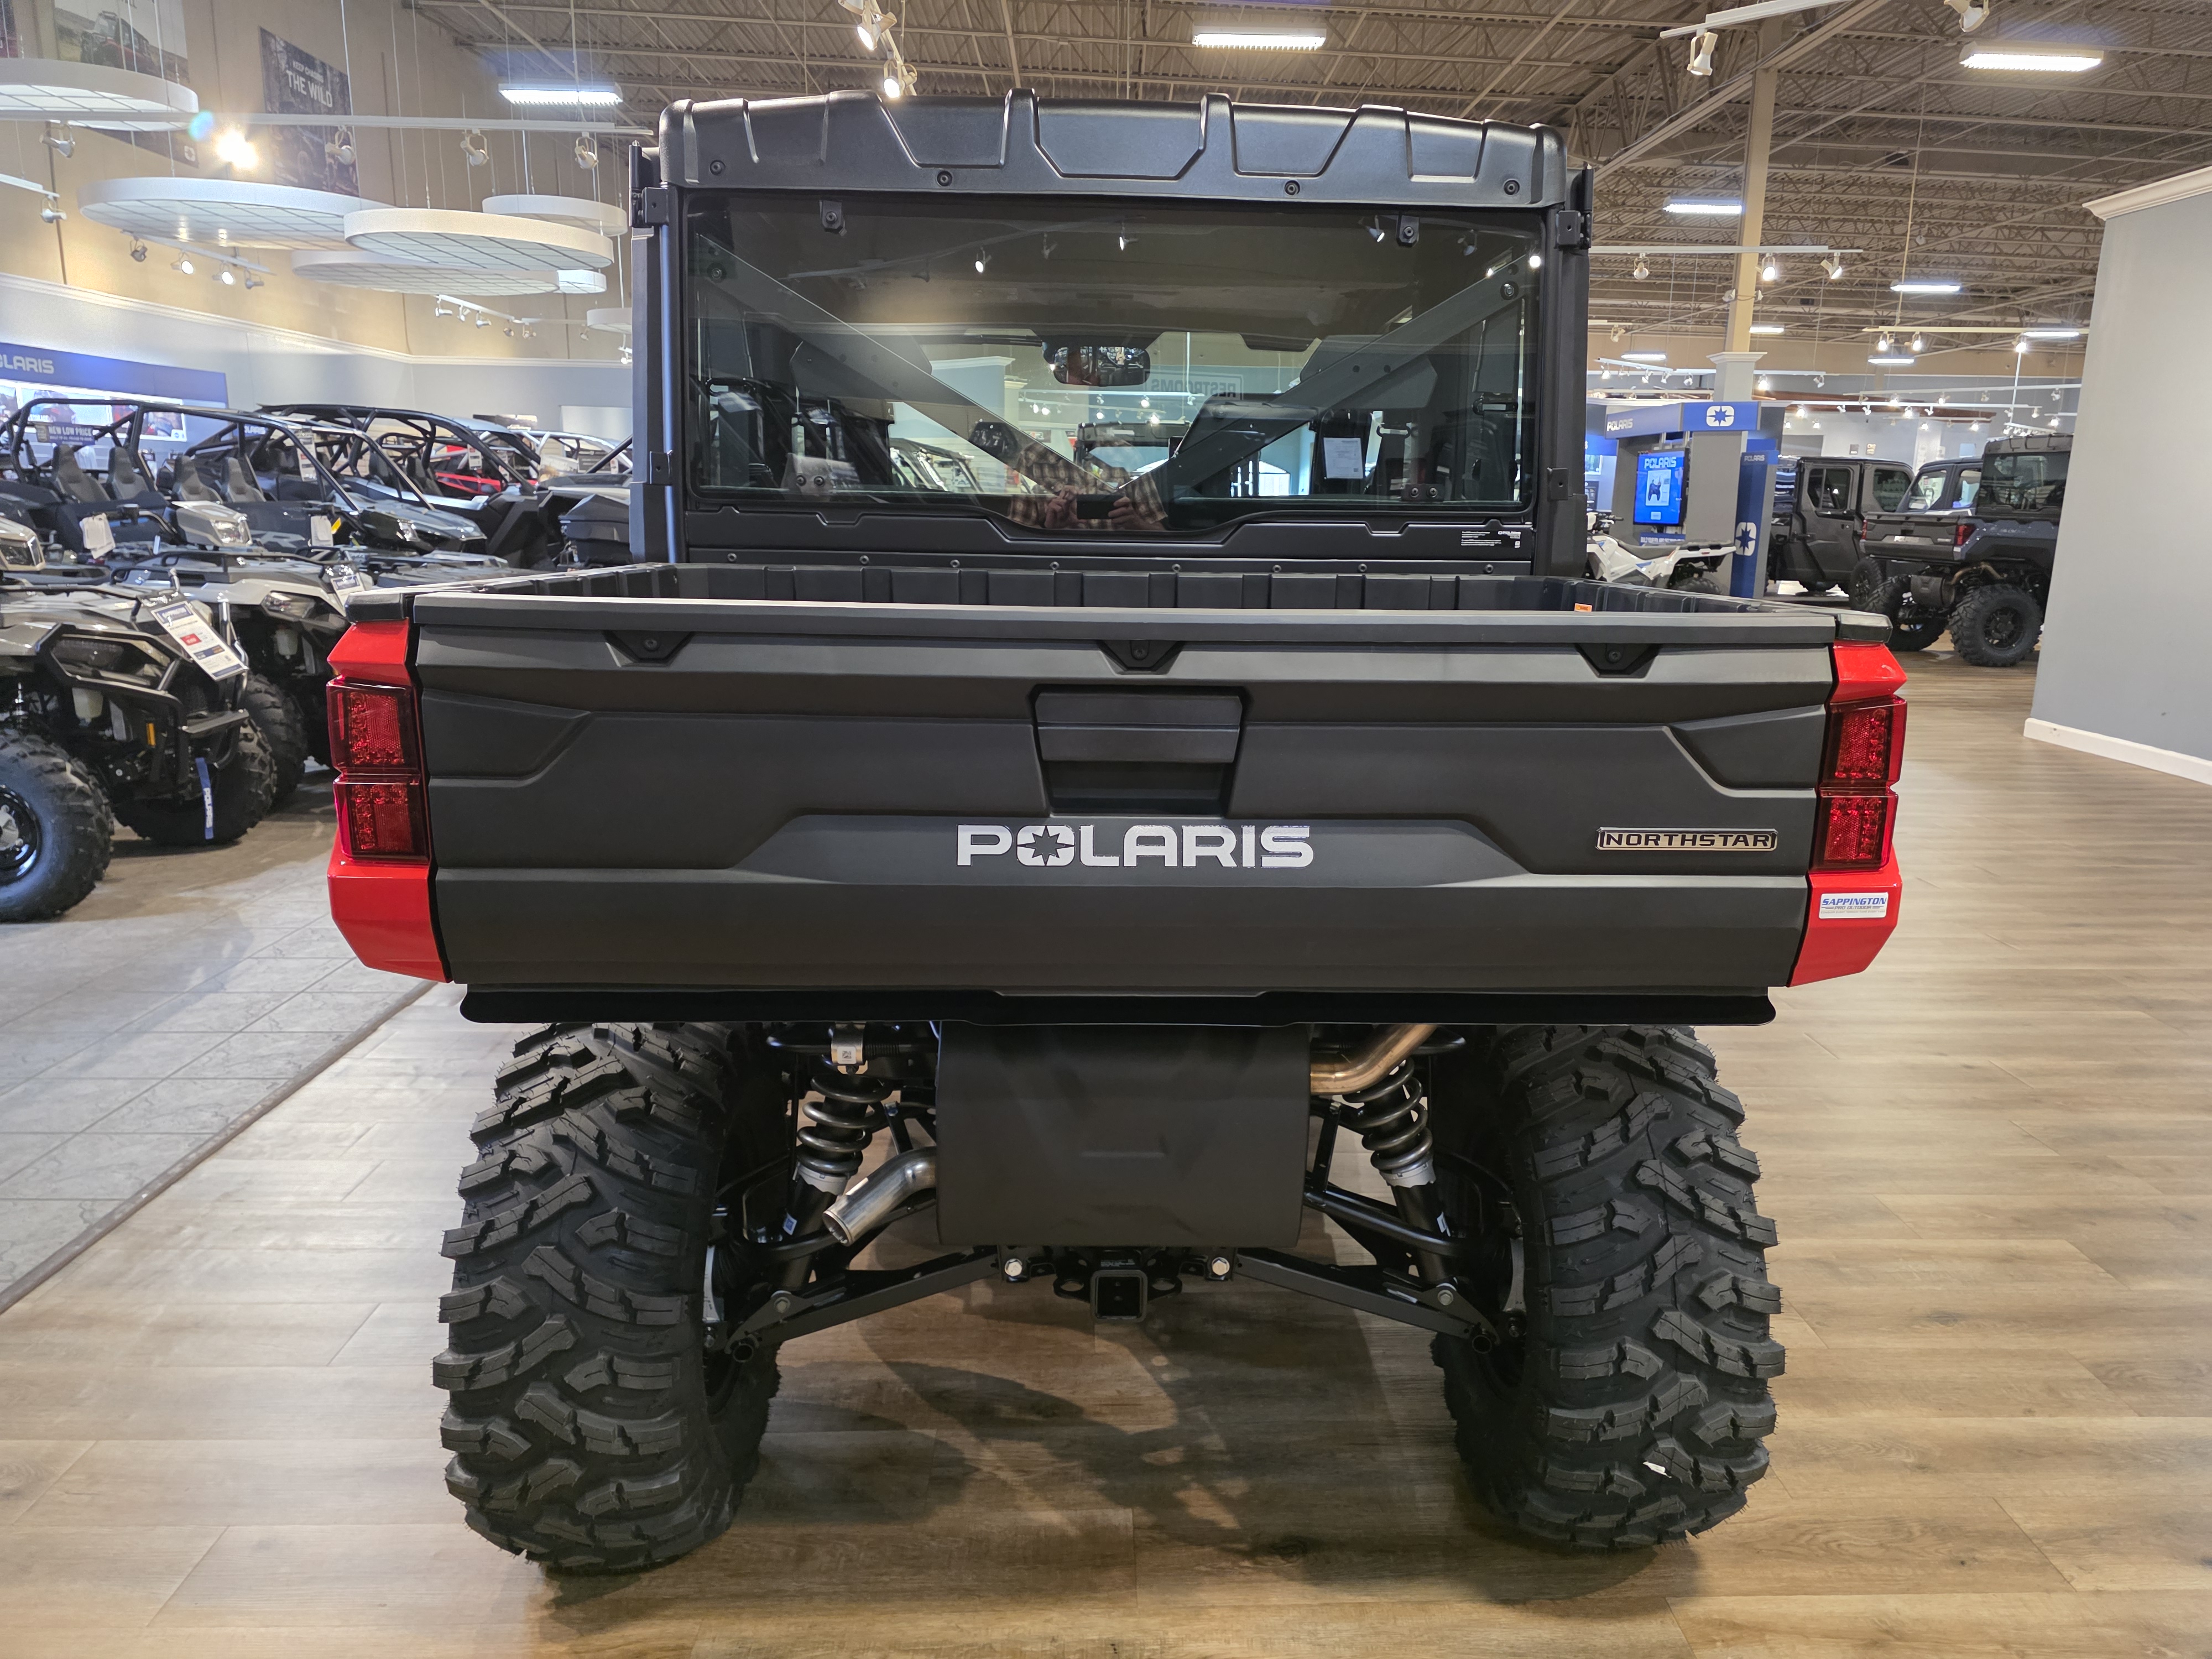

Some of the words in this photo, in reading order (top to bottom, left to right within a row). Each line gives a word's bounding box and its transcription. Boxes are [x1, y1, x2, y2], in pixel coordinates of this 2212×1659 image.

[286, 70, 307, 95] THE
[307, 81, 333, 108] WILD
[1606, 418, 1634, 431] POLARIS
[1644, 456, 1677, 469] POLARIS
[203, 787, 213, 828] POLARIS
[957, 824, 1314, 868] POLARIS
[1606, 833, 1769, 847] NORTHSTAR
[1822, 898, 1887, 906] SAPPINGTON
